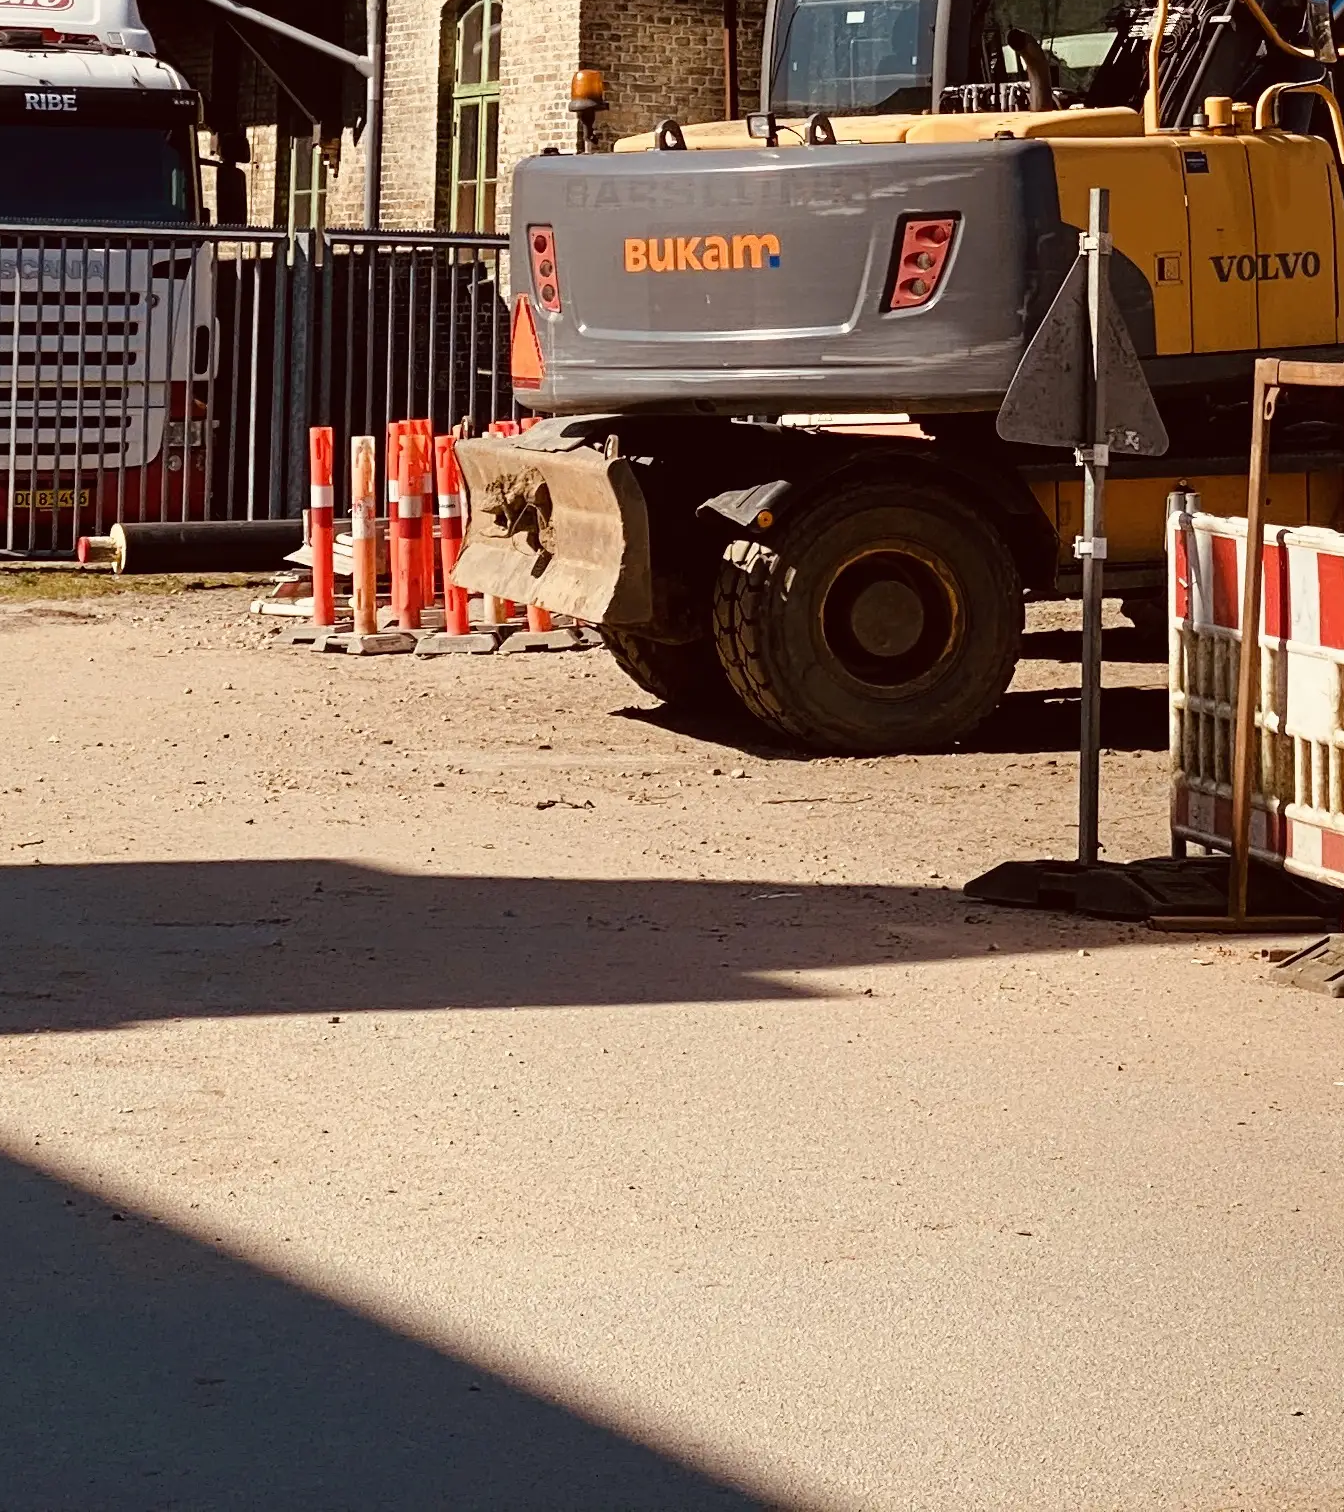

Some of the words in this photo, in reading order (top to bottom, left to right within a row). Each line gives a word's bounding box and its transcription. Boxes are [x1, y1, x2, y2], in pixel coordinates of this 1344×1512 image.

[24, 92, 77, 111] RIBE
[0, 259, 106, 279] SCANIA
[1208, 251, 1321, 283] VOLVO
